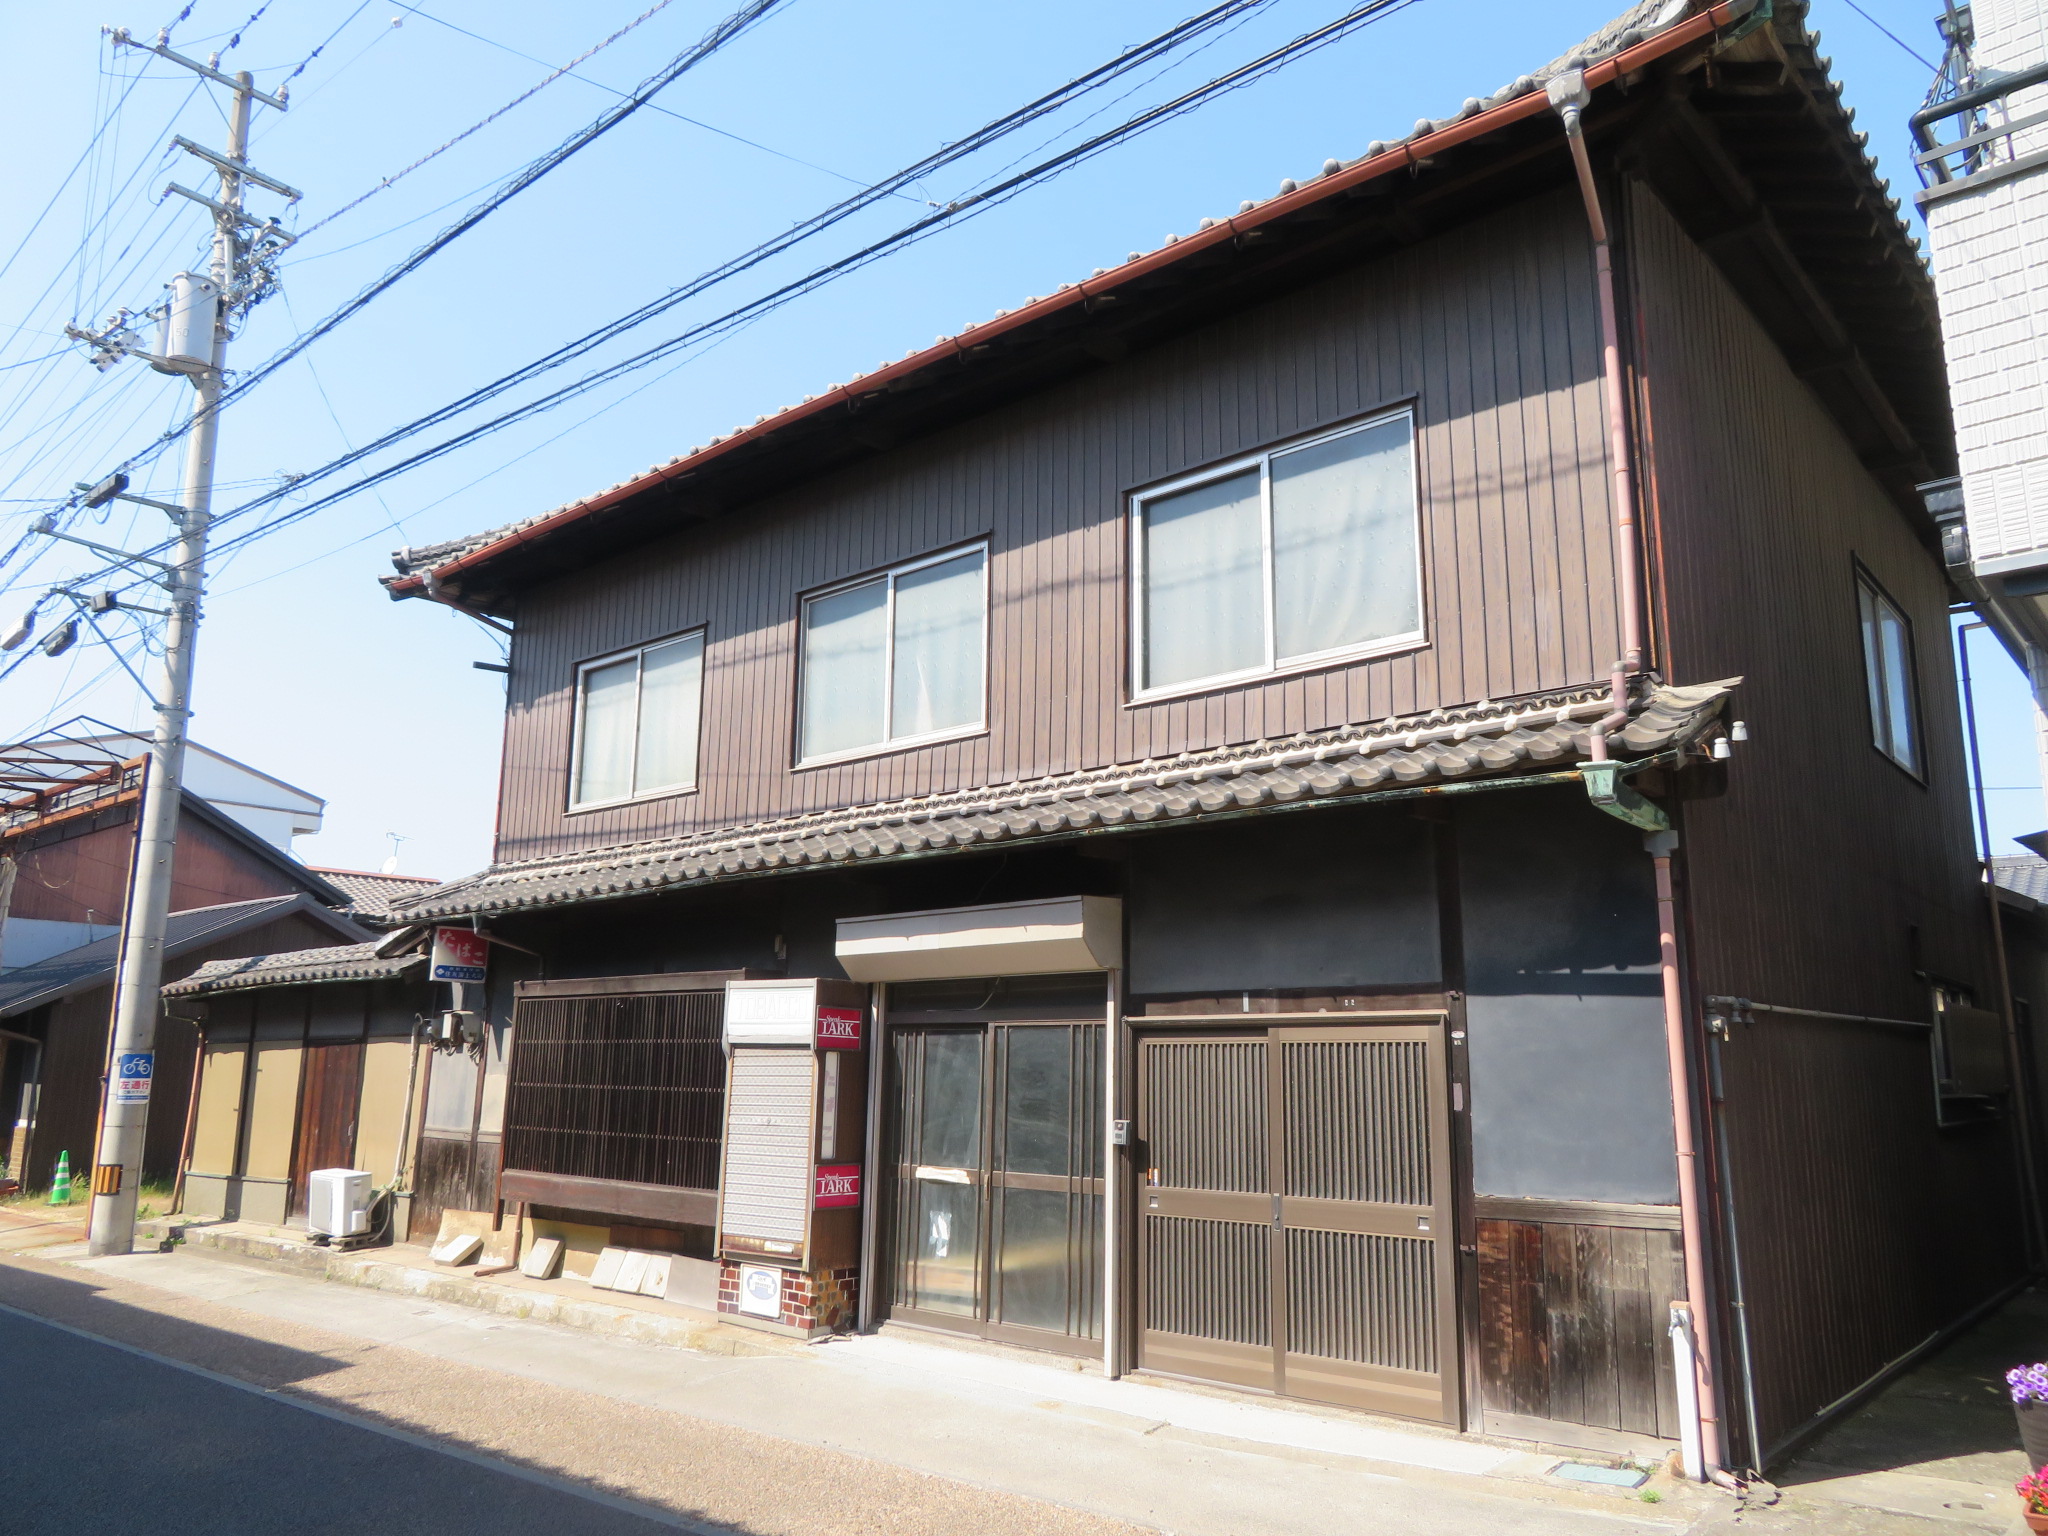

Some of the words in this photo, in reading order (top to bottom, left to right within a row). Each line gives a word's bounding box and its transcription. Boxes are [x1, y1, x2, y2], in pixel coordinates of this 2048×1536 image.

[441, 930, 484, 965] たばこ
[821, 1021, 854, 1036] LARK
[120, 1080, 149, 1089] 左通行
[820, 1179, 853, 1194] LARK
